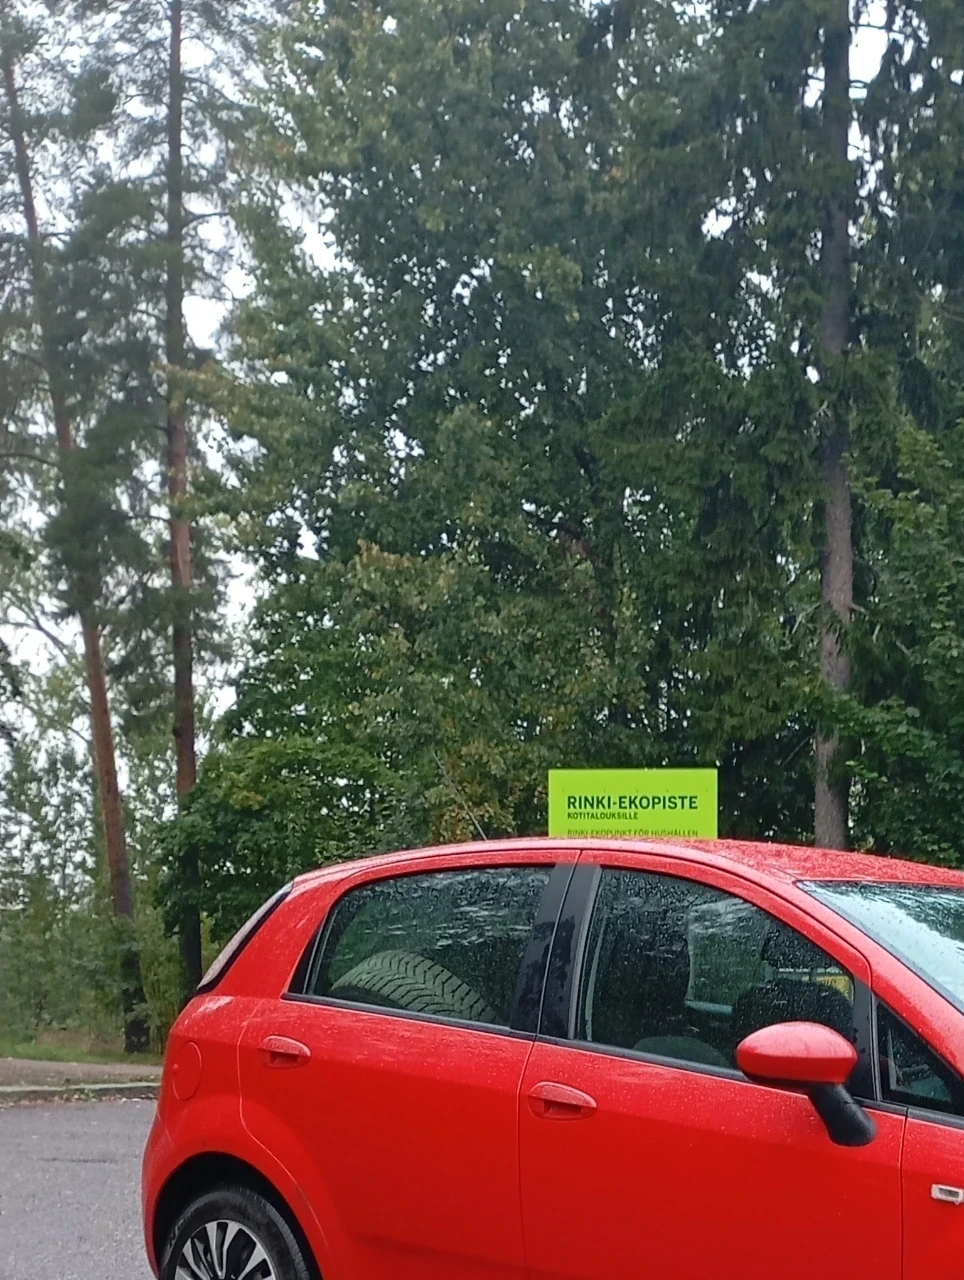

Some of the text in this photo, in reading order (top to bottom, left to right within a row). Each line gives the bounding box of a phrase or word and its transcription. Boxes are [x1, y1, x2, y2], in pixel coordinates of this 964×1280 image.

[567, 796, 698, 810] RINKI-EKOPISTE
[567, 812, 639, 820] KOTITALOUKSILLE
[633, 828, 650, 838] FÖR
[651, 828, 699, 837] HUSHÅLLEN
